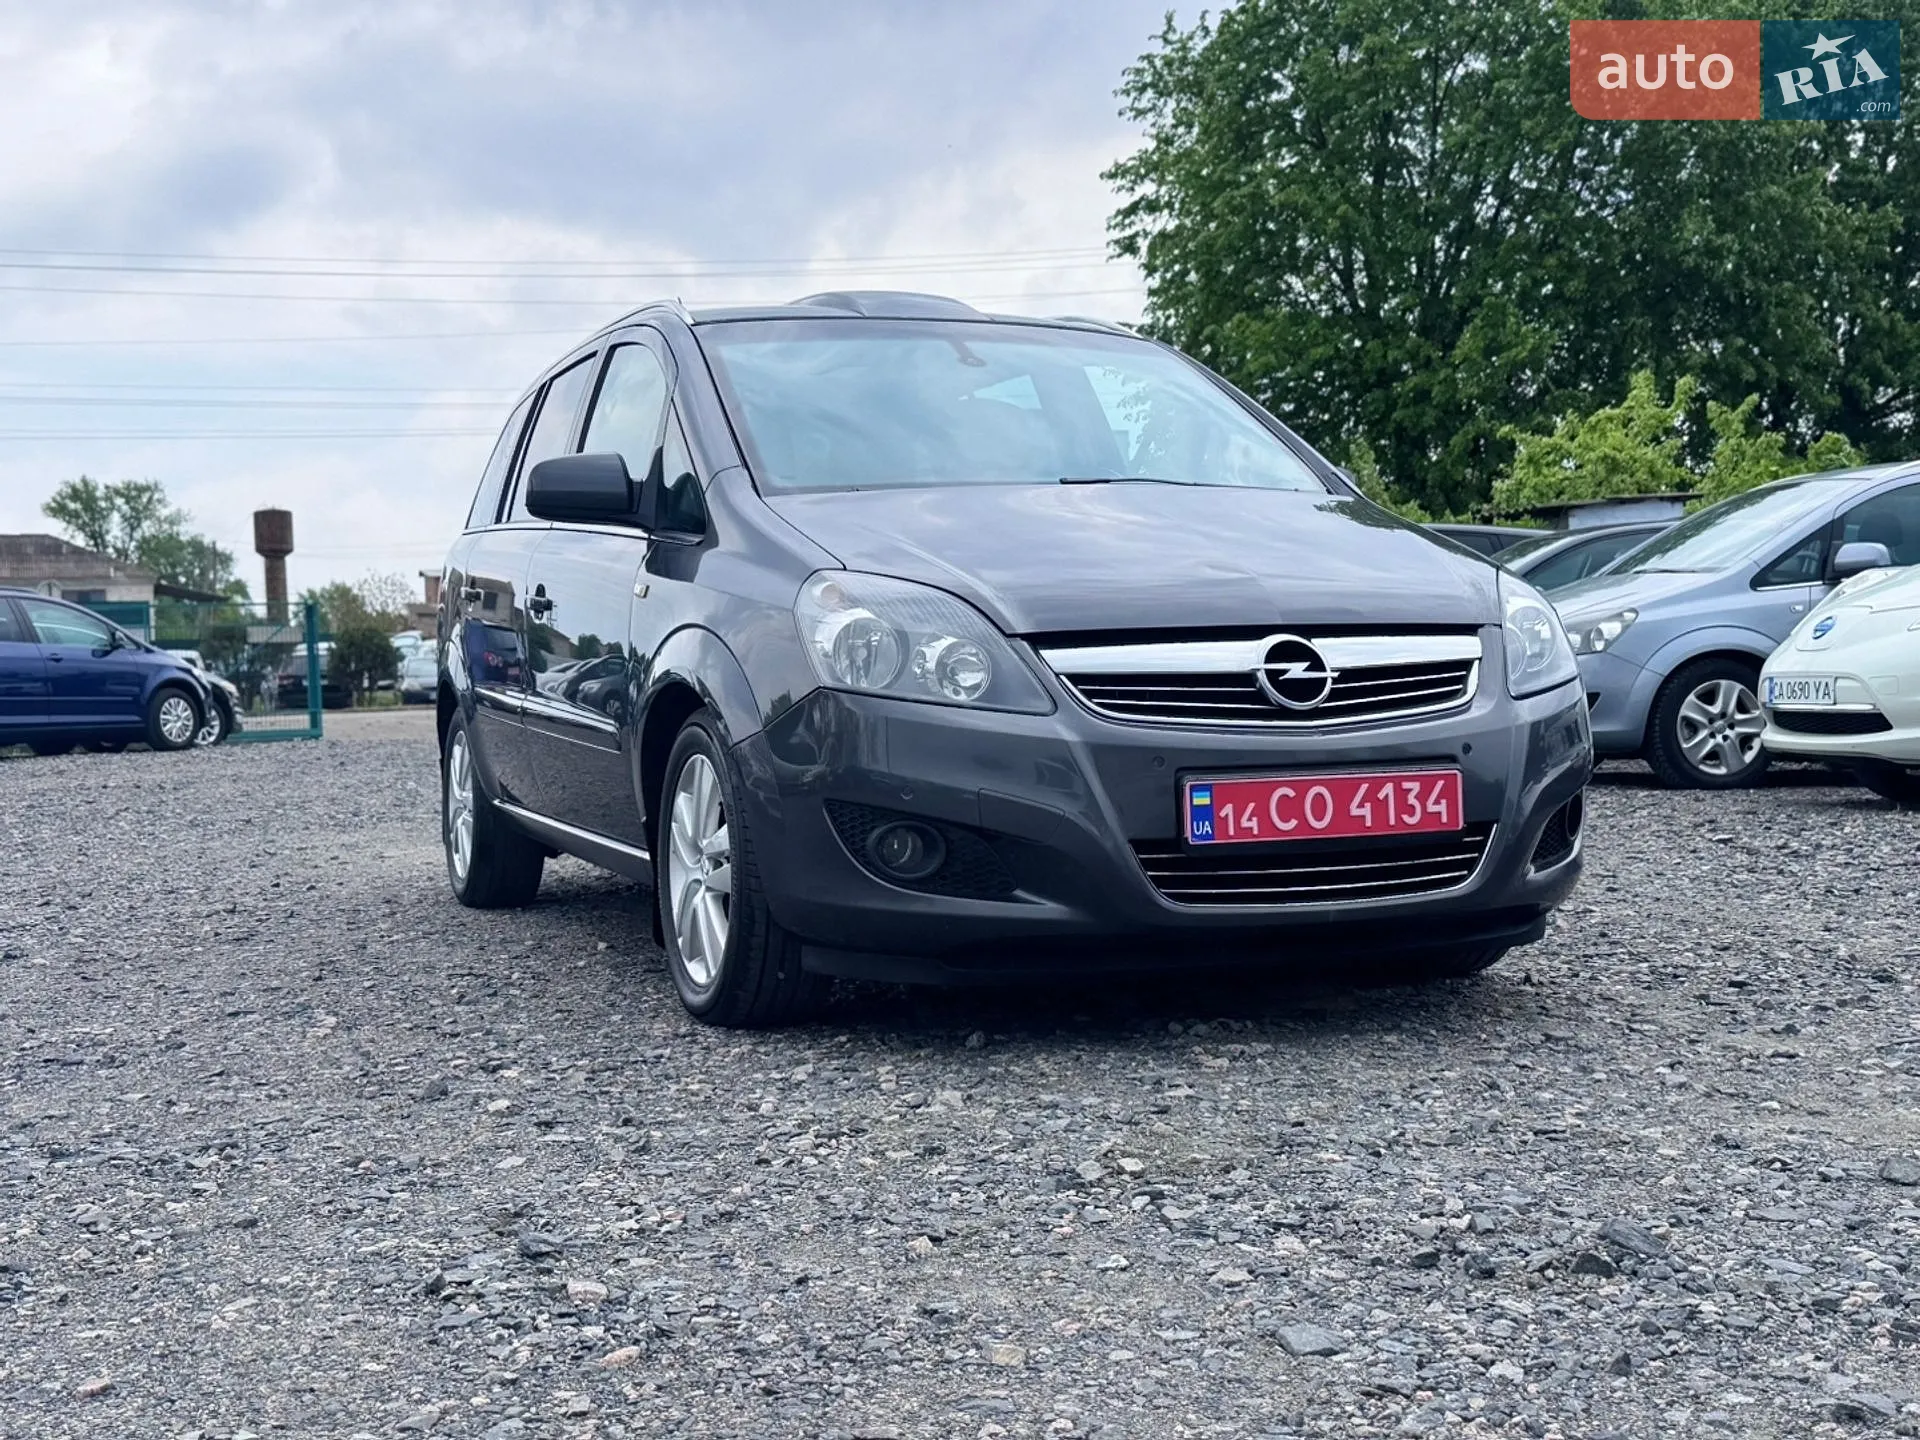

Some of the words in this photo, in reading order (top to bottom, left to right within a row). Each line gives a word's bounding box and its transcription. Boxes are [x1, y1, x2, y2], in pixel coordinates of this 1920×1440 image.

[1786, 681, 1811, 700] 0690
[1813, 681, 1832, 700] YA
[1219, 802, 1259, 836] 14
[1269, 786, 1333, 831] CO
[1349, 780, 1448, 827] 4134
[1193, 820, 1212, 835] UA
